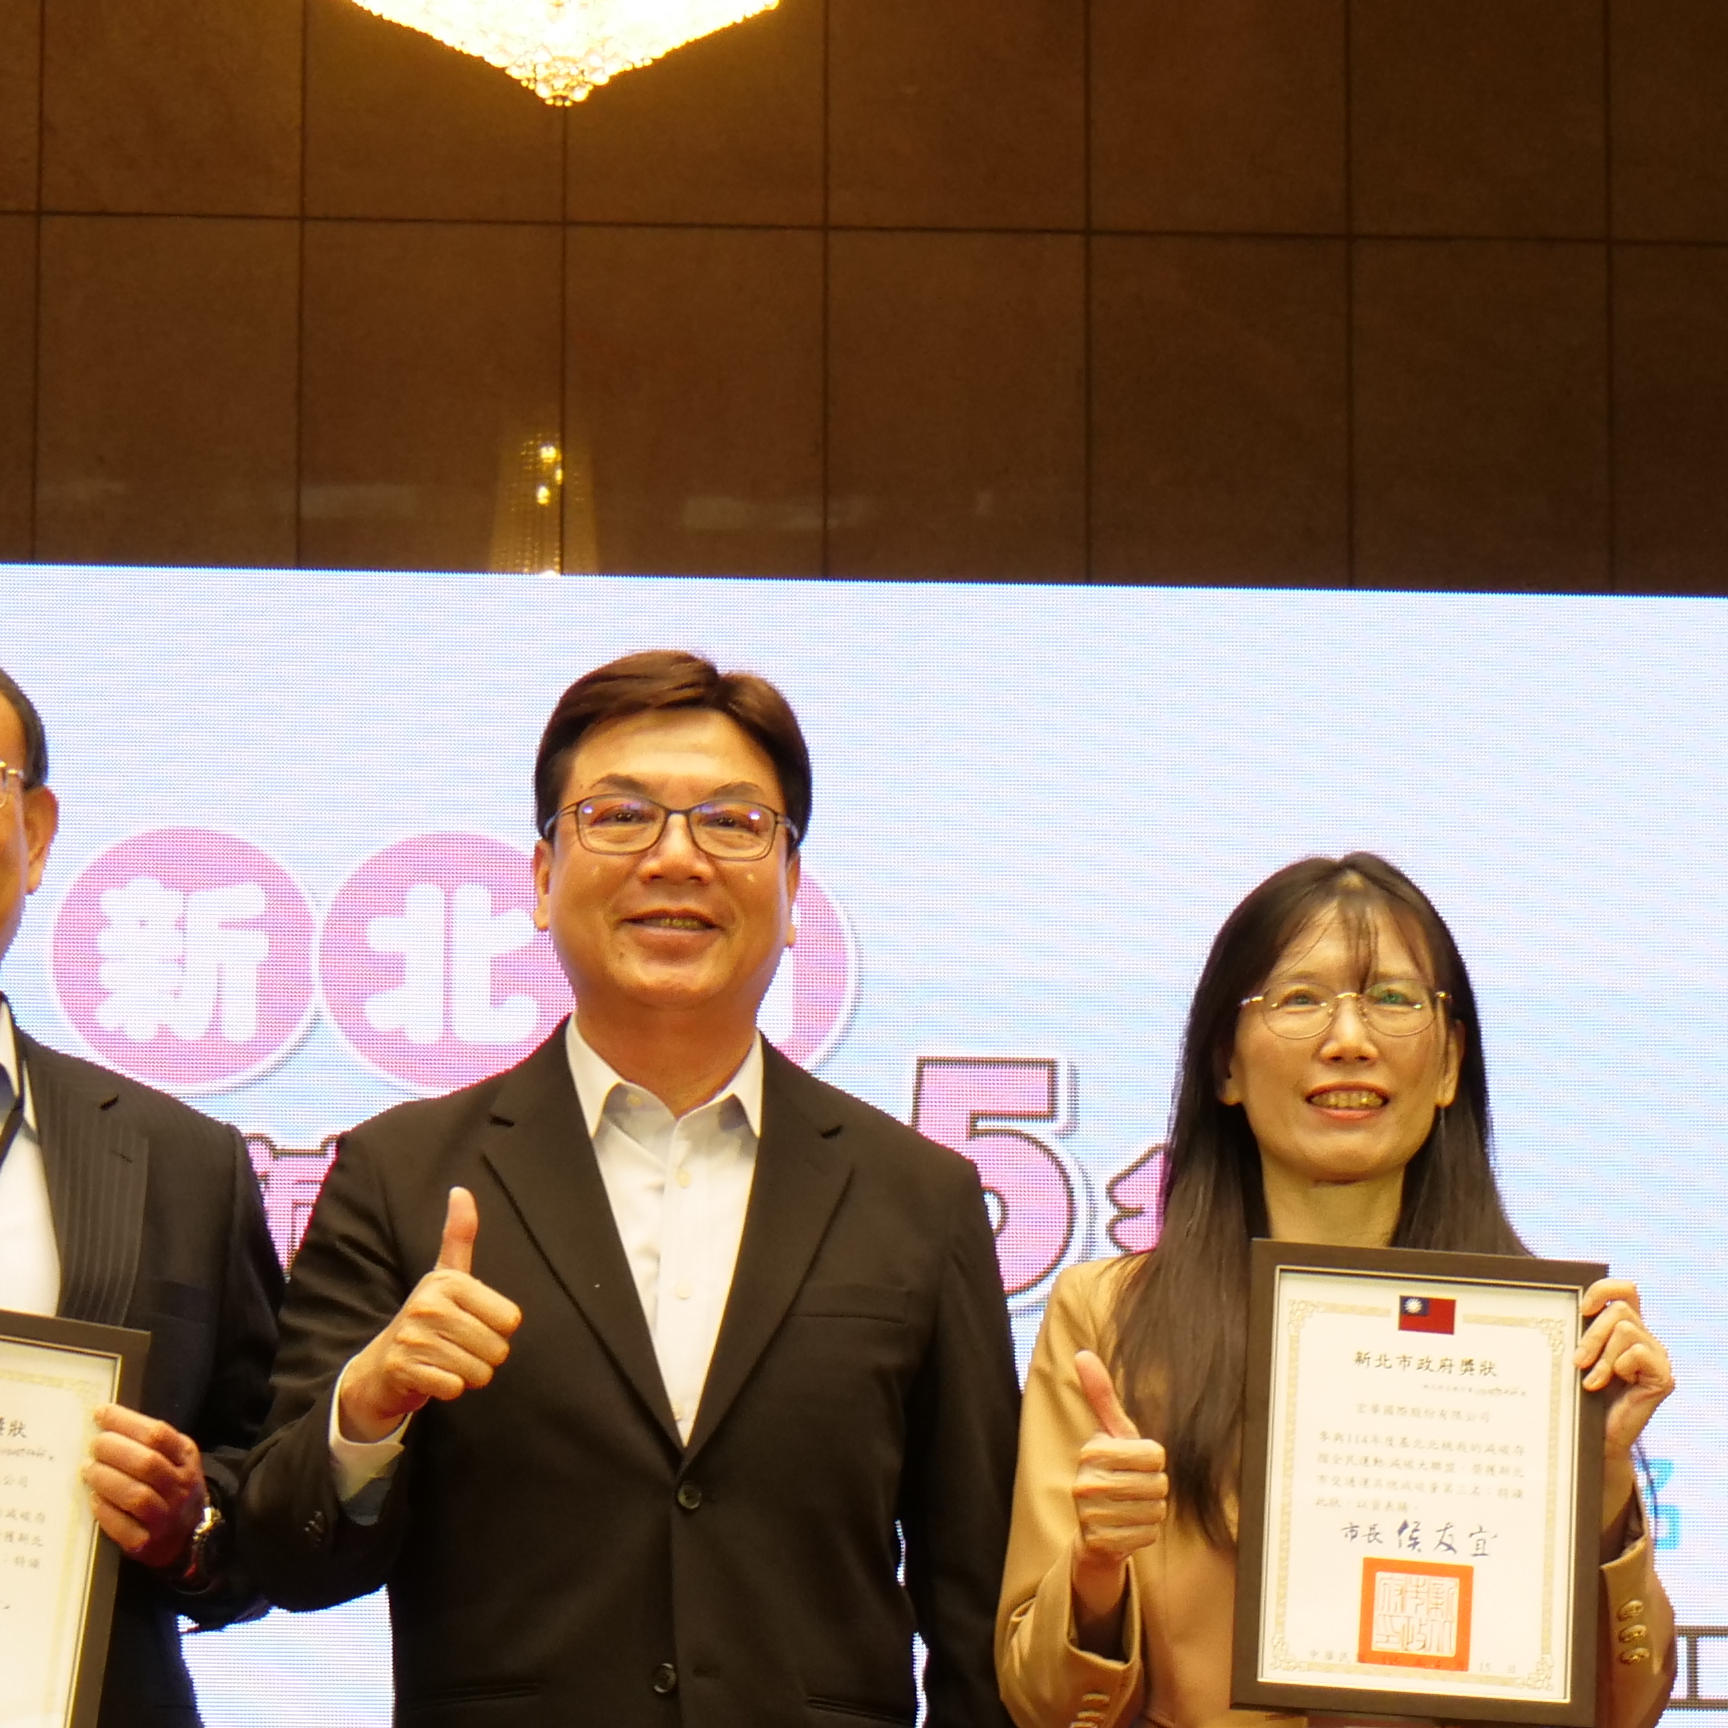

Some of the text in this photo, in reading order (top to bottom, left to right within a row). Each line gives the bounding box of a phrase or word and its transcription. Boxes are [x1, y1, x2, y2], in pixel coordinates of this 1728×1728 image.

[99, 876, 799, 1044] 新北
[1353, 1349, 1498, 1378] 新北市政府獎狀
